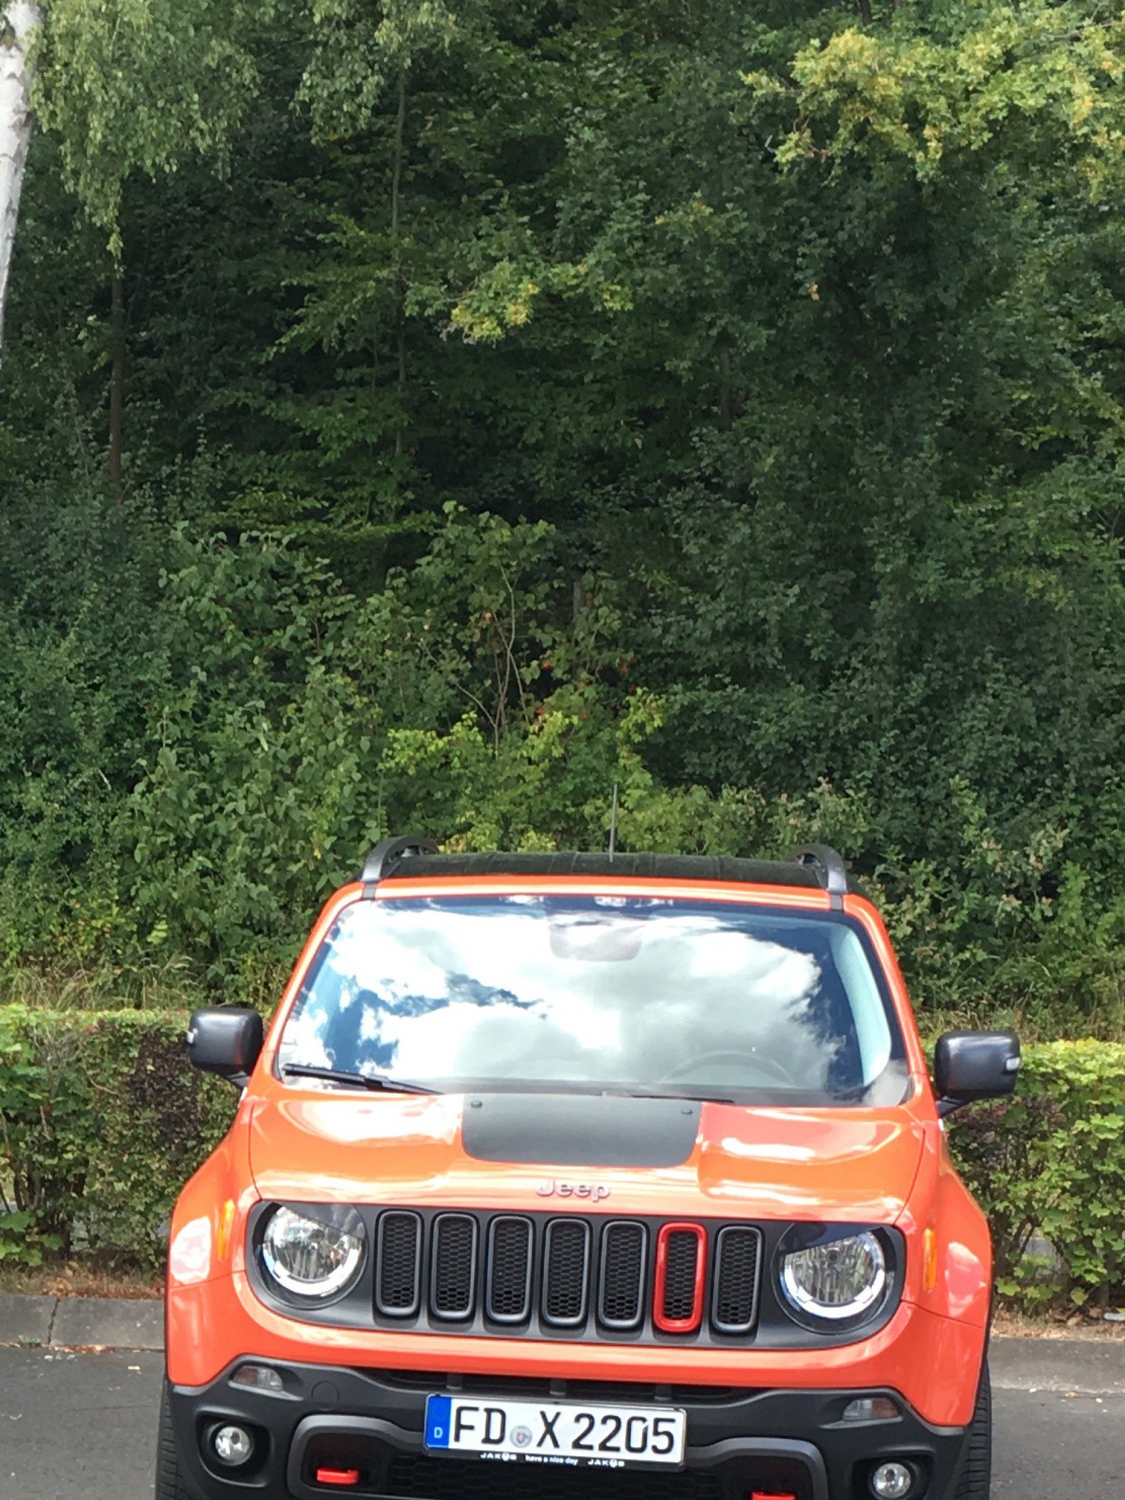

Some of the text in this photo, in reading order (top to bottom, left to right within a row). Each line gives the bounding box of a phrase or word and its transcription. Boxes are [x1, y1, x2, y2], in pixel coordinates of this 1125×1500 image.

[535, 1179, 611, 1203] Jeep
[433, 1405, 677, 1455] D FD X 2205
[565, 1457, 579, 1467] day
